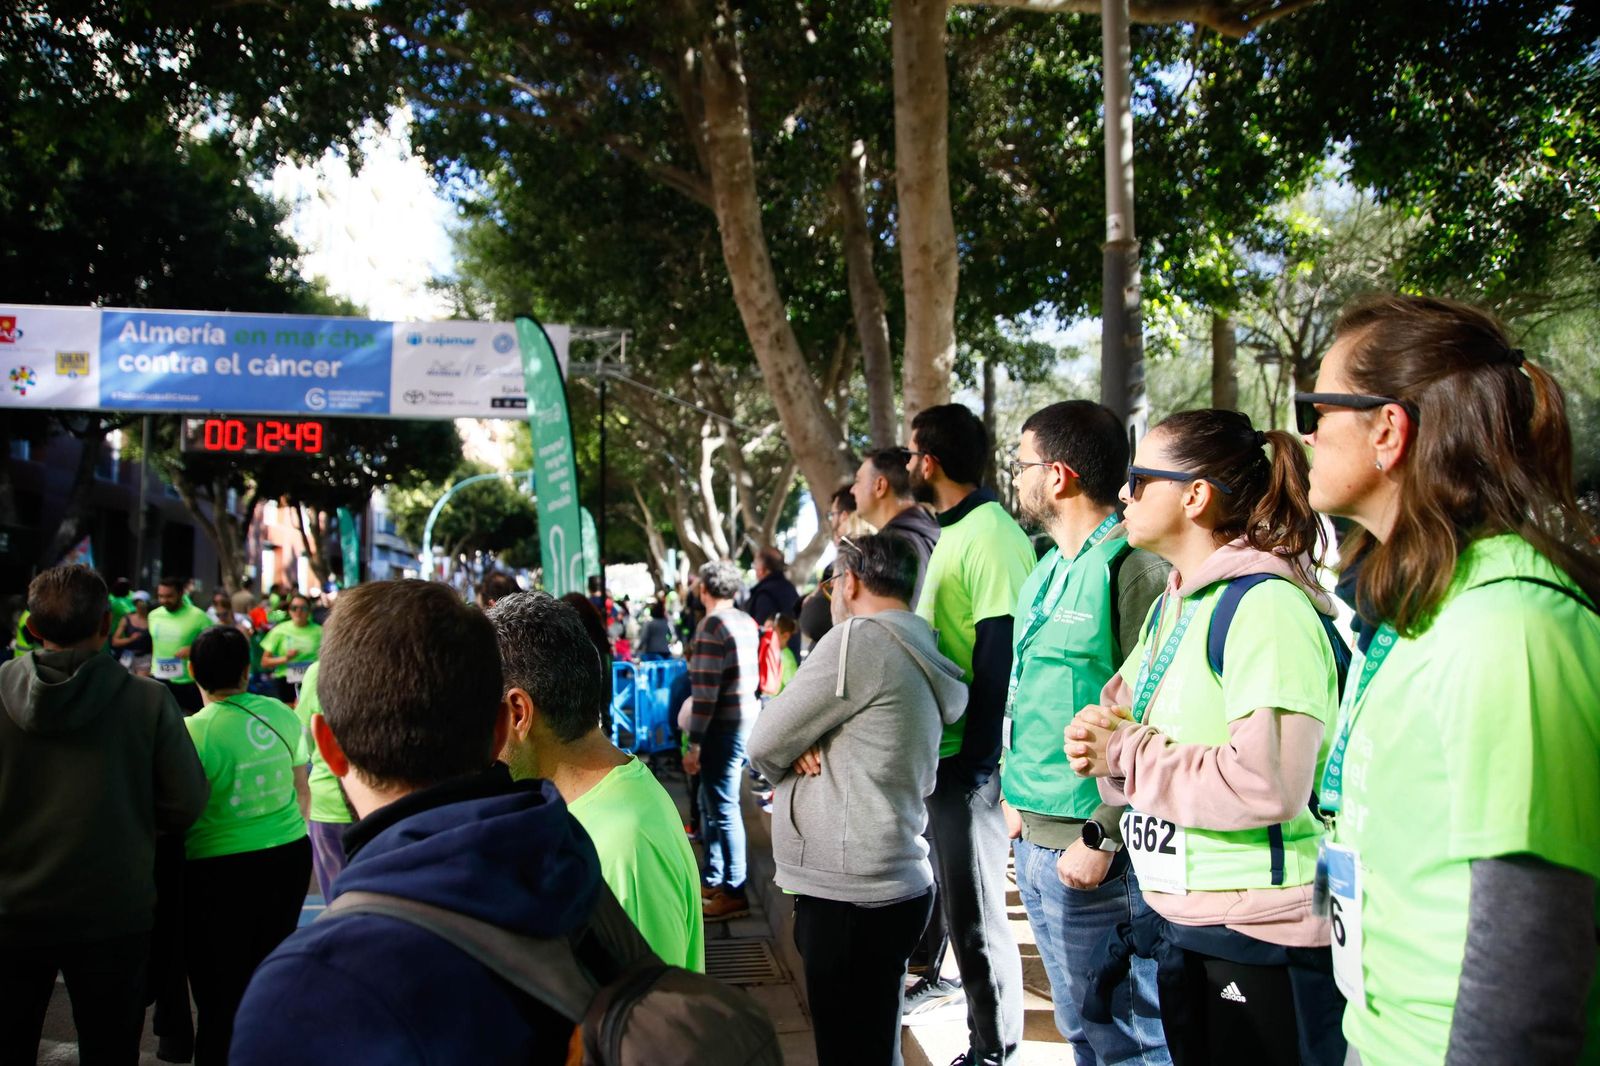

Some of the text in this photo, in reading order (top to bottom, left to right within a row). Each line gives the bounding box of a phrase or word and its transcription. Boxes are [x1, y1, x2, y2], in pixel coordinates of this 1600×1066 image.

[118, 320, 377, 349] Almería en marcha
[425, 333, 477, 348] cajamar
[118, 352, 342, 379] contra el cáncer
[1123, 814, 1177, 855] 1562
[1220, 992, 1247, 1003] adidas
